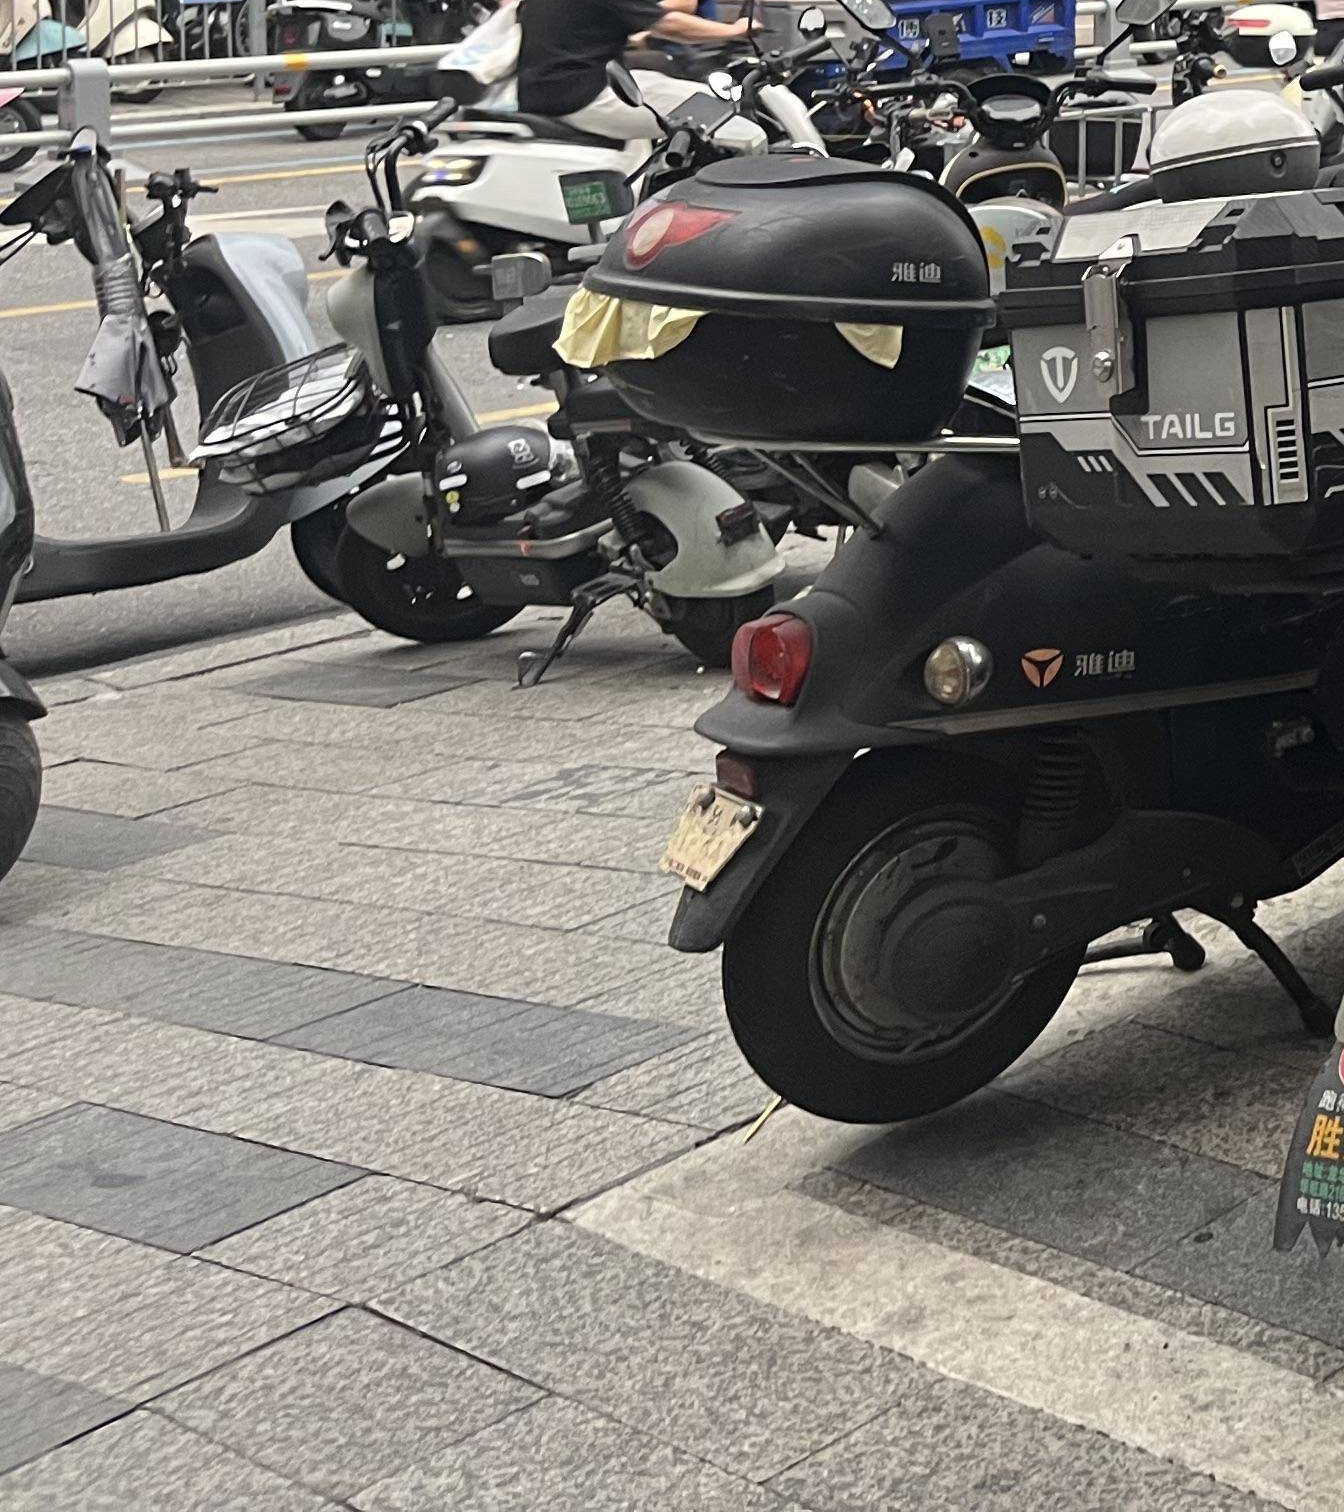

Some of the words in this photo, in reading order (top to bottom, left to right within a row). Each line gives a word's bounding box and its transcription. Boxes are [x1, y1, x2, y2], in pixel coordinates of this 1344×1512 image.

[890, 262, 942, 284] 雅迪
[1139, 411, 1236, 440] TAILG
[1074, 648, 1136, 677] 雅迪
